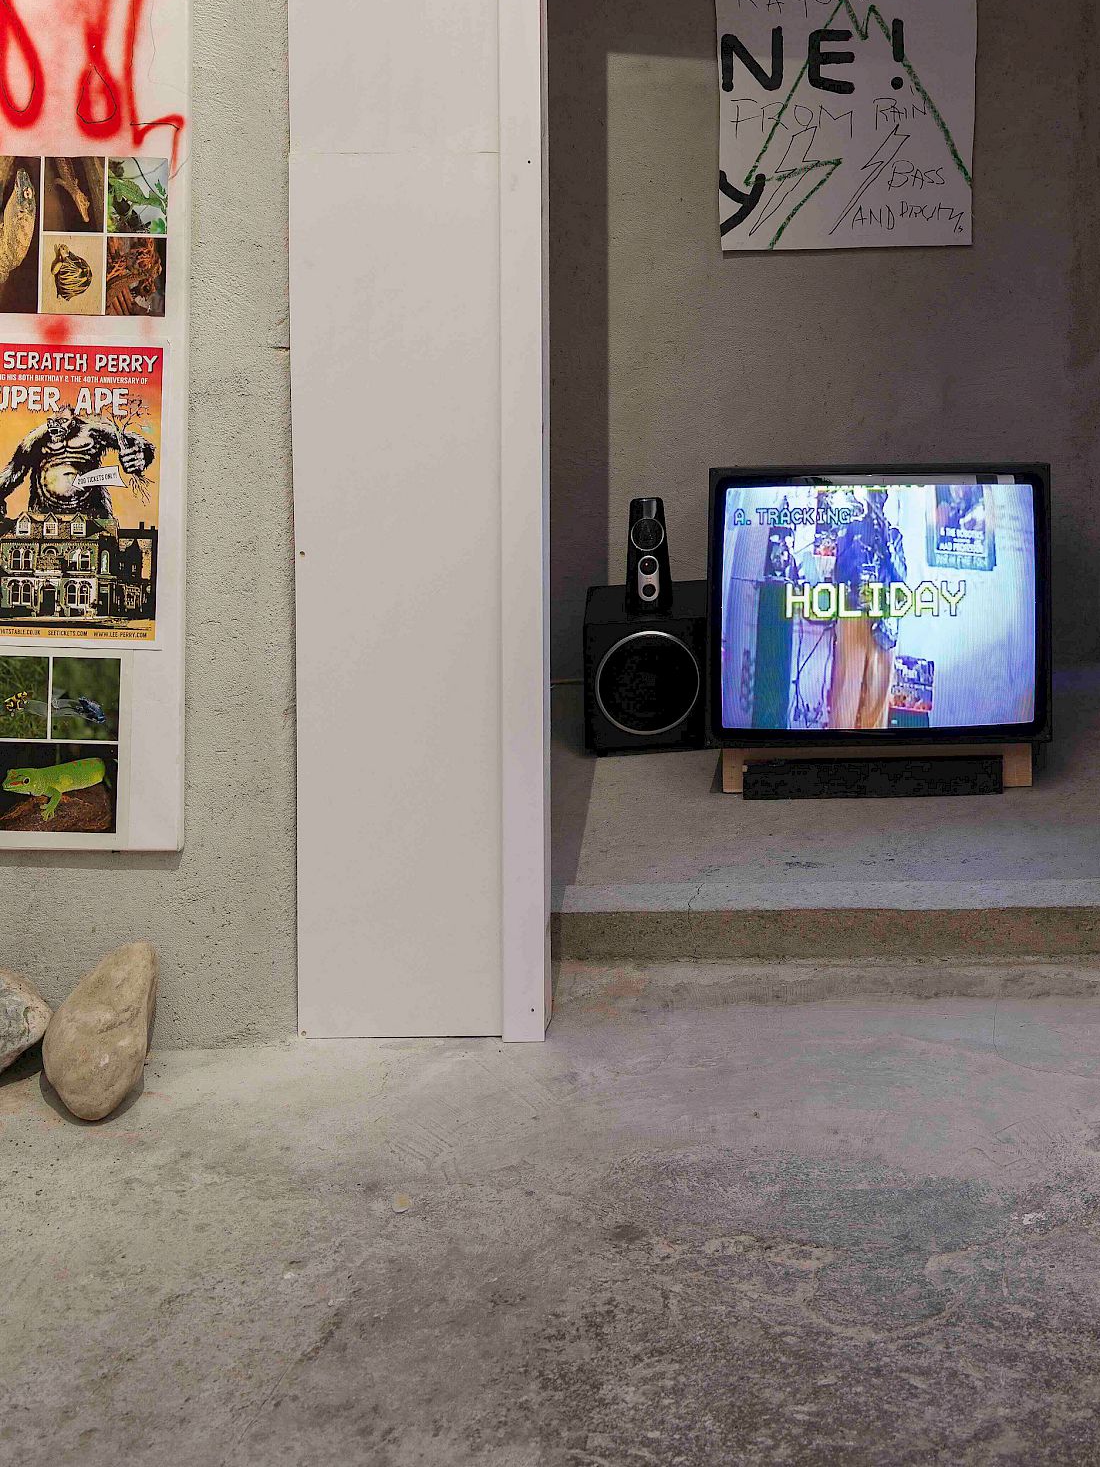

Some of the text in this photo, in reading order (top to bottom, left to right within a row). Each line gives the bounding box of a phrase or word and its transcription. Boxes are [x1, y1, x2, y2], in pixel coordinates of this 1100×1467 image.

[3, 351, 159, 373] SCRATCH PERRY
[7, 374, 17, 382] HIS
[18, 374, 34, 382] 80TH
[34, 374, 65, 382] BIRTHDAY
[71, 375, 82, 383] THE
[99, 376, 140, 385] ANNIVERSARY
[74, 387, 130, 417] APE
[755, 507, 852, 526] TRACKING
[784, 579, 967, 620] HOLIDAY
[47, 629, 88, 637] SEETICKETS.COM
